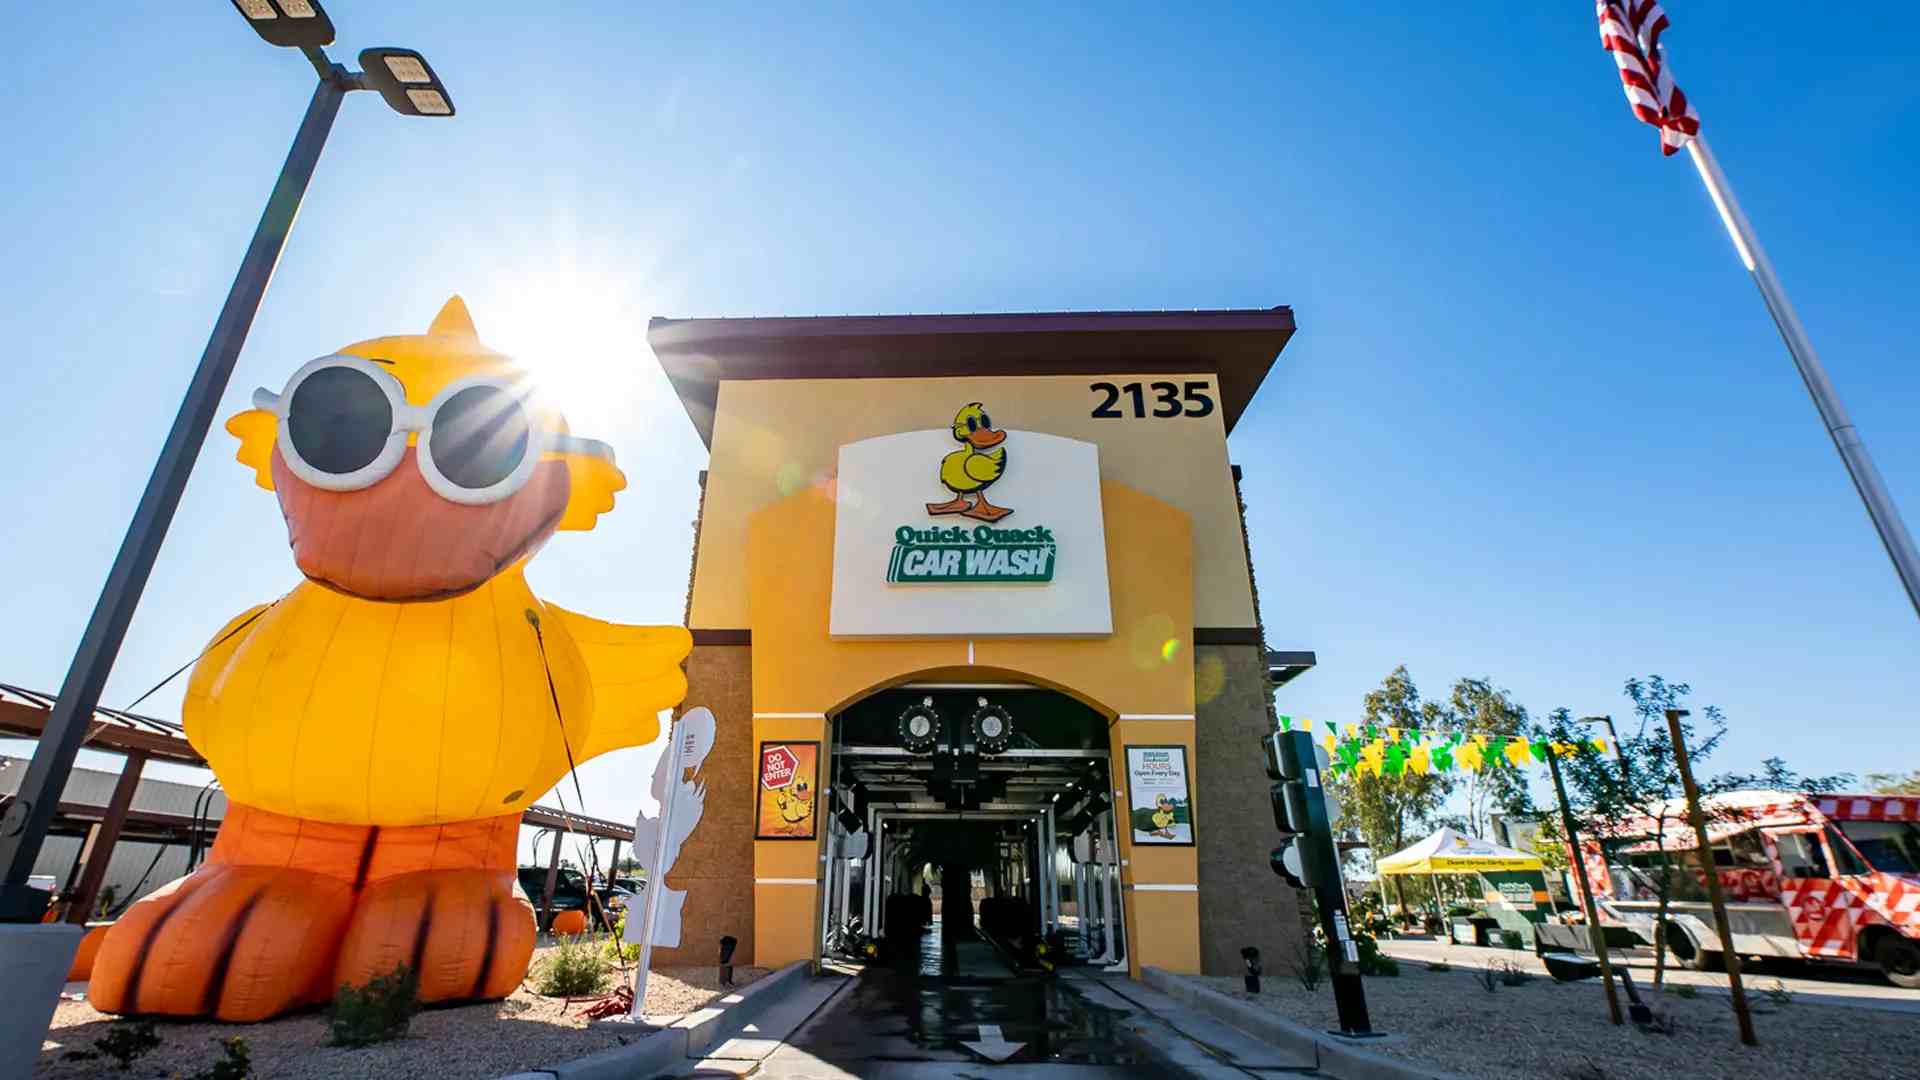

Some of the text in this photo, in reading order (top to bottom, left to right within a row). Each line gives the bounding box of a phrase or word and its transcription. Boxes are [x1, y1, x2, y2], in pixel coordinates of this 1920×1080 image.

[1089, 381, 1215, 418] 2135
[895, 525, 1055, 547] Quick Quack
[903, 549, 1048, 576] CAR WASH
[767, 753, 782, 763] DO
[767, 760, 785, 772] NOT
[764, 768, 792, 781] ENTER
